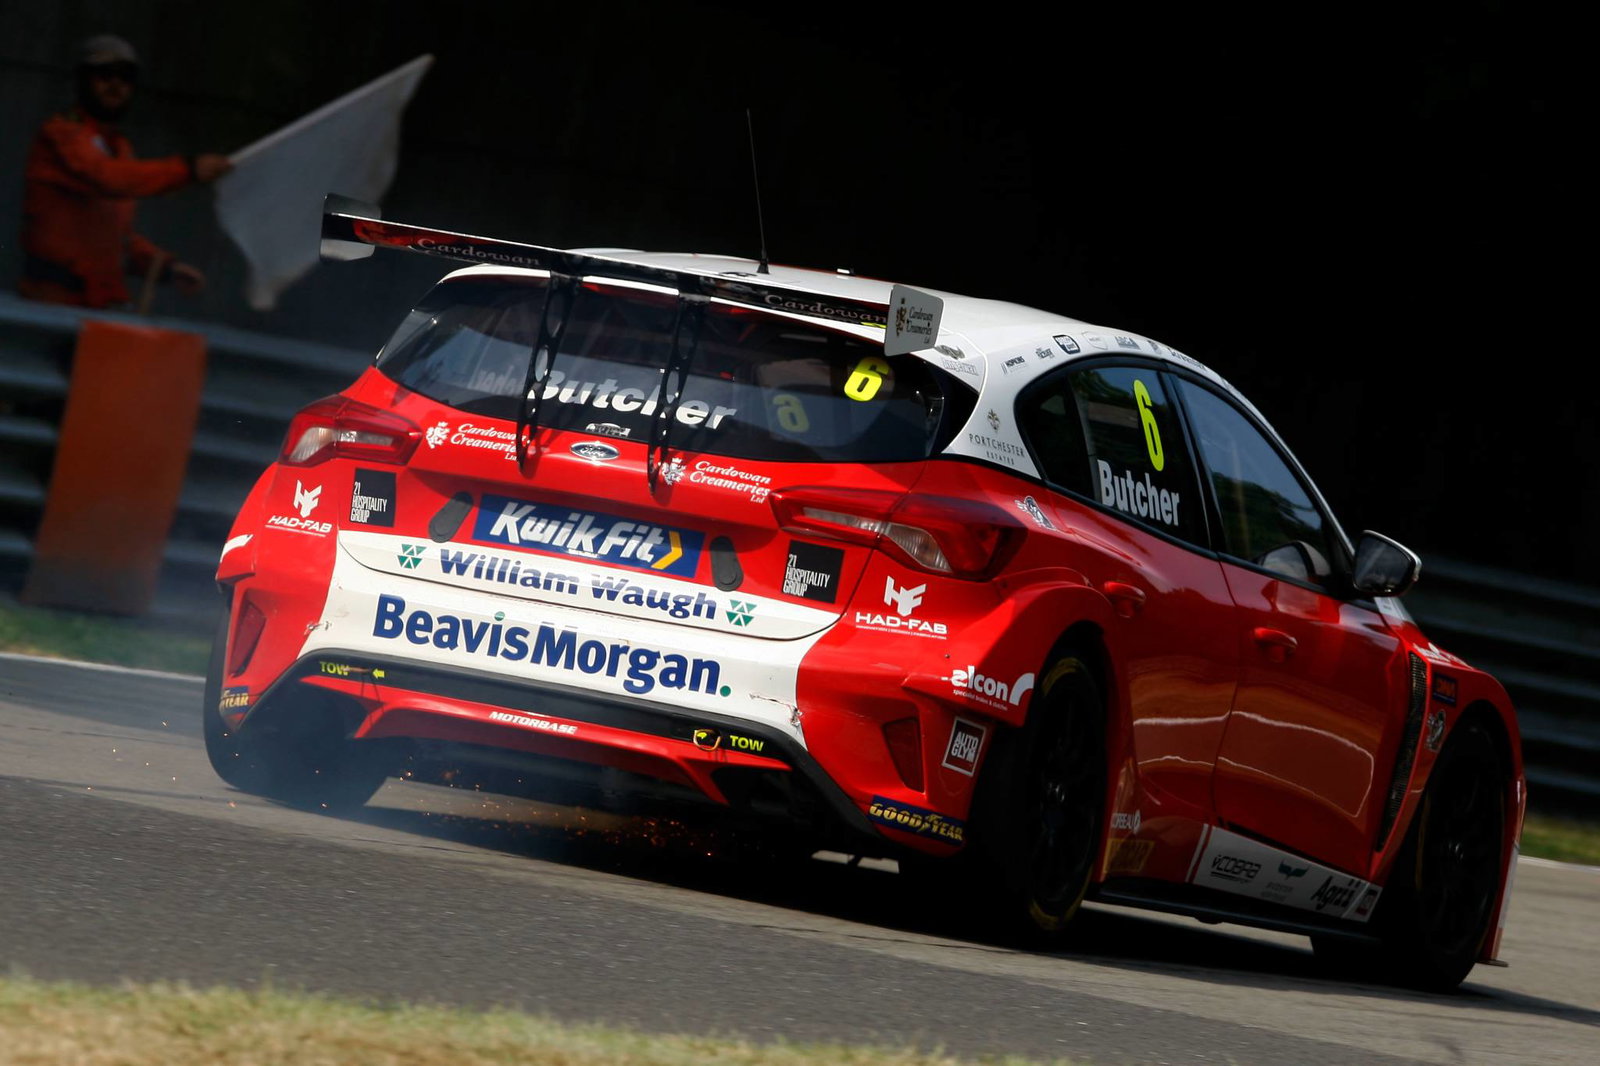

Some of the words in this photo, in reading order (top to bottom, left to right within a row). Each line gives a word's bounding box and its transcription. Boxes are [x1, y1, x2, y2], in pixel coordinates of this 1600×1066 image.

[417, 237, 540, 266] Cardowan
[764, 293, 888, 324] Cardowan
[844, 357, 890, 402] 6
[1133, 379, 1165, 472] 6
[450, 433, 517, 454] Creamerie
[969, 433, 1025, 458] PORTCHESTER
[689, 470, 771, 497] Creameries
[695, 460, 772, 484] Cardowan
[353, 481, 361, 496] 21
[1097, 459, 1180, 527] Butcher
[350, 508, 371, 523] GROUP
[352, 495, 388, 513] HOSPITALITY
[267, 515, 333, 534] HAD-FAB
[787, 553, 798, 568] 21
[440, 548, 580, 595] William
[591, 573, 717, 620] Waugh
[782, 579, 808, 598] GROUP
[785, 566, 831, 589] HOSPITALITY
[855, 611, 948, 635] HAD-FAB
[319, 661, 350, 676] TOW
[950, 665, 1009, 702] alcon
[488, 711, 578, 735] MOTORBASE
[729, 735, 765, 752] TOW
[954, 731, 979, 749] AUTO
[950, 743, 976, 763] GLYM
